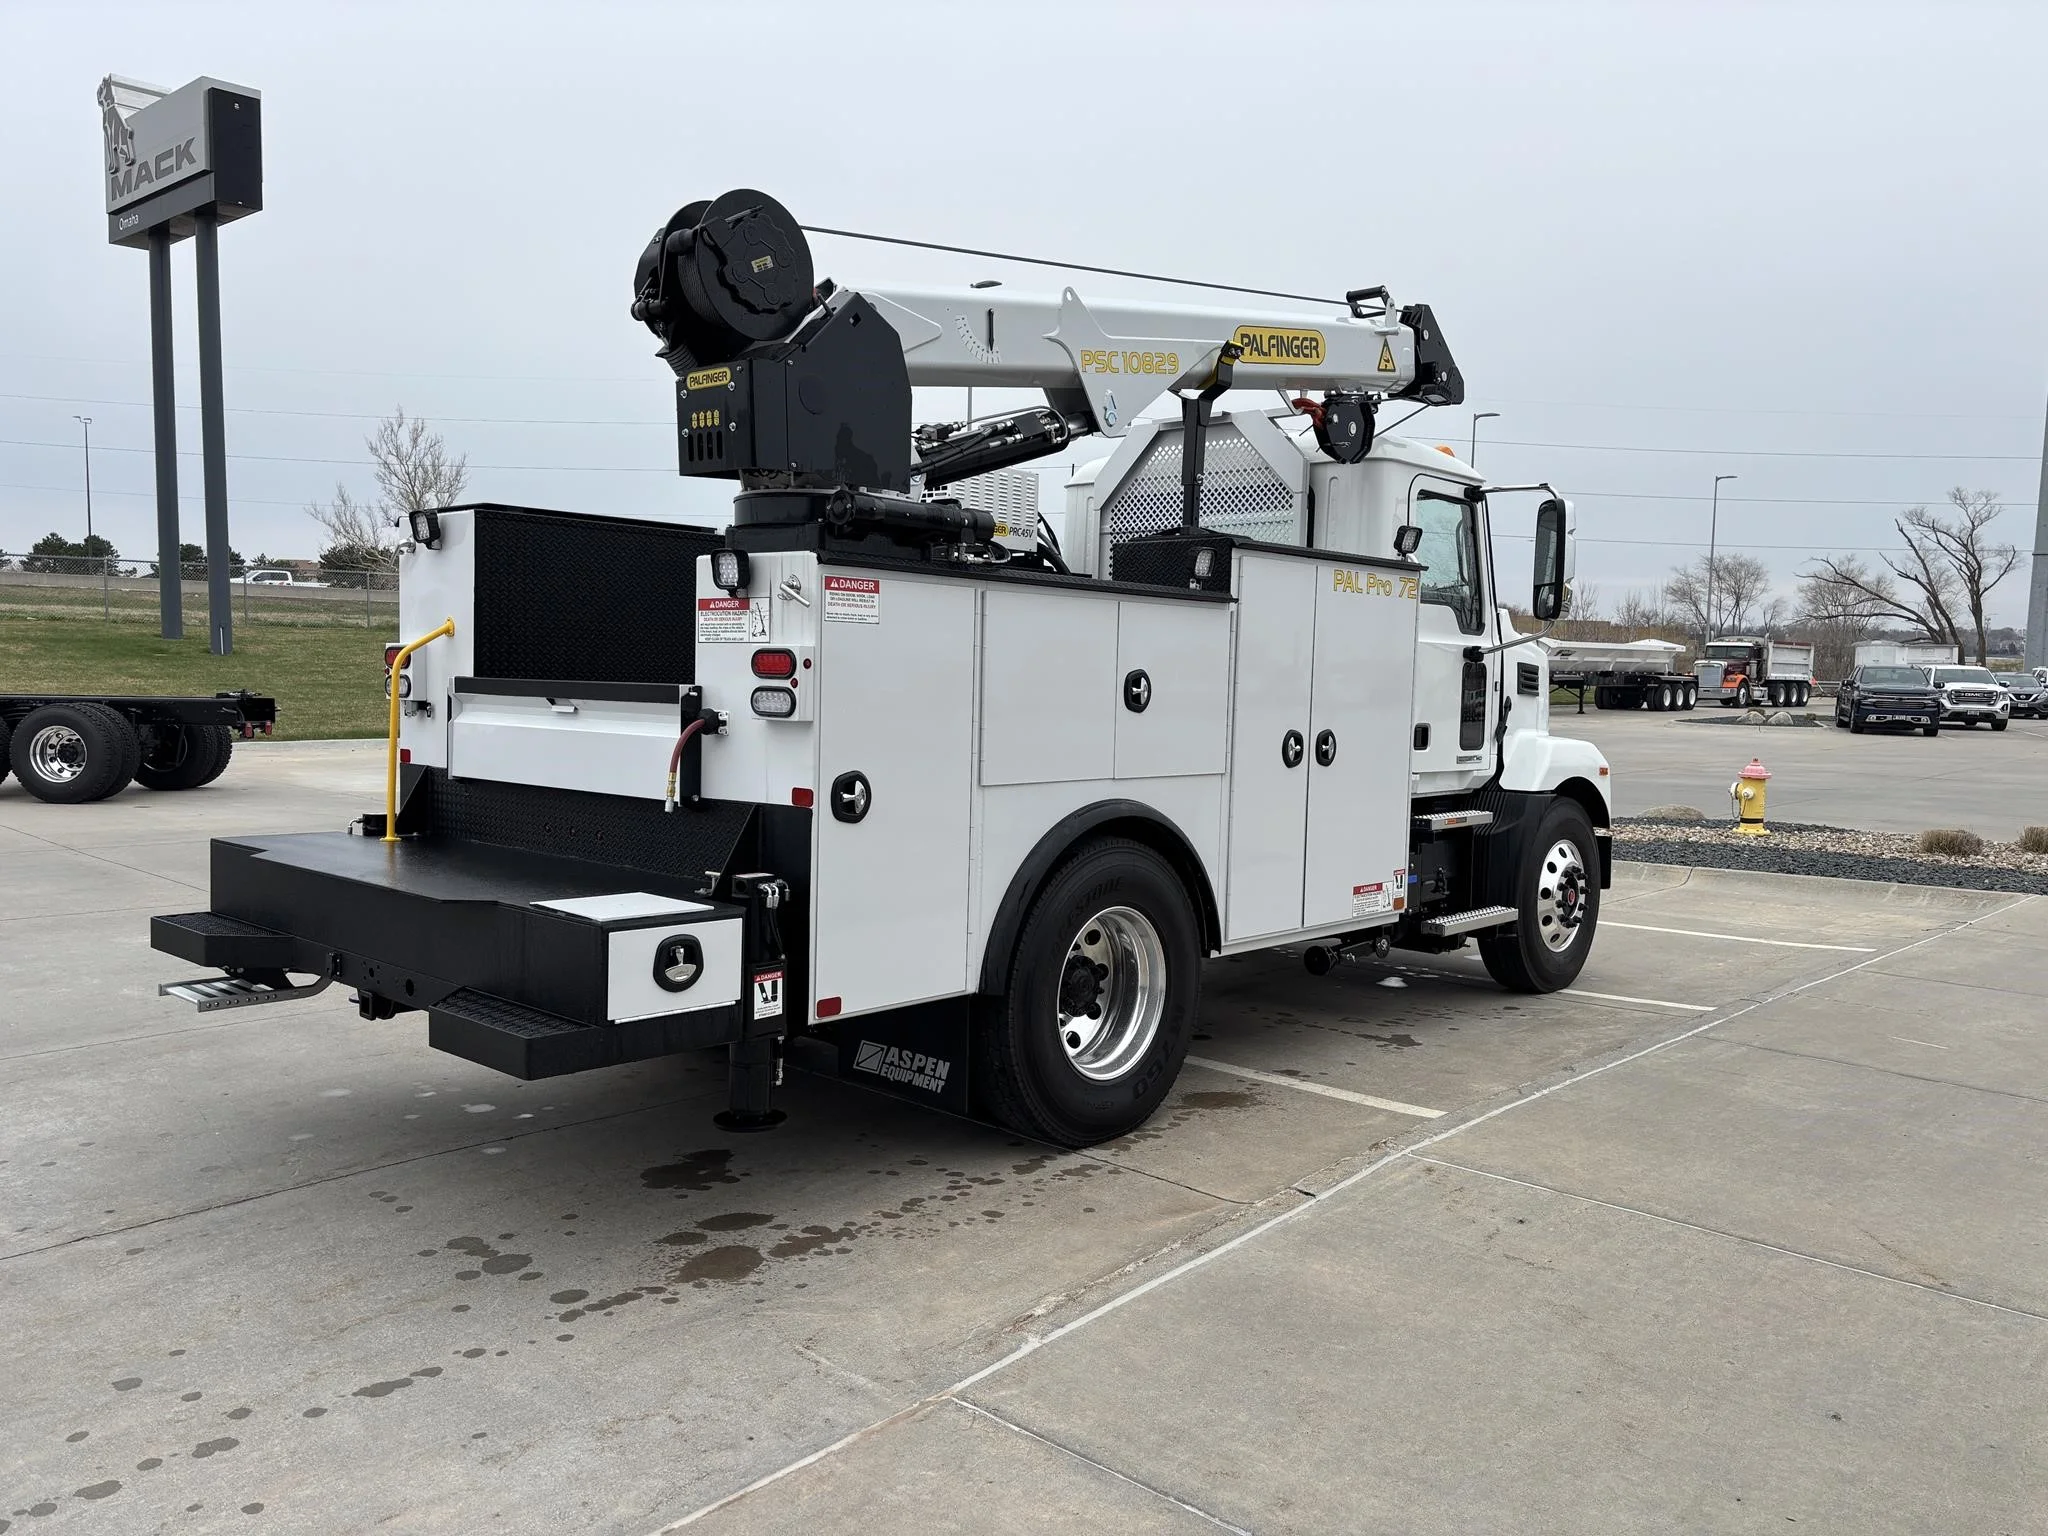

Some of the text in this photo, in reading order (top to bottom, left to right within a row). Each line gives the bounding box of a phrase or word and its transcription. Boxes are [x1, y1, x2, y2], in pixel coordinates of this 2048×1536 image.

[111, 137, 197, 201] MACK
[119, 213, 139, 231] Omaha
[1240, 333, 1320, 359] PALFINGER
[689, 371, 728, 388] PALFINGER
[1008, 526, 1034, 538] PRC45V
[839, 579, 875, 591] DANGER
[1333, 569, 1418, 600] PAL Pro 72
[715, 600, 740, 609] DANGER
[761, 971, 782, 980] DANGER
[884, 1046, 951, 1080] ASPEN
[880, 1063, 946, 1093] EQUIPMENT
